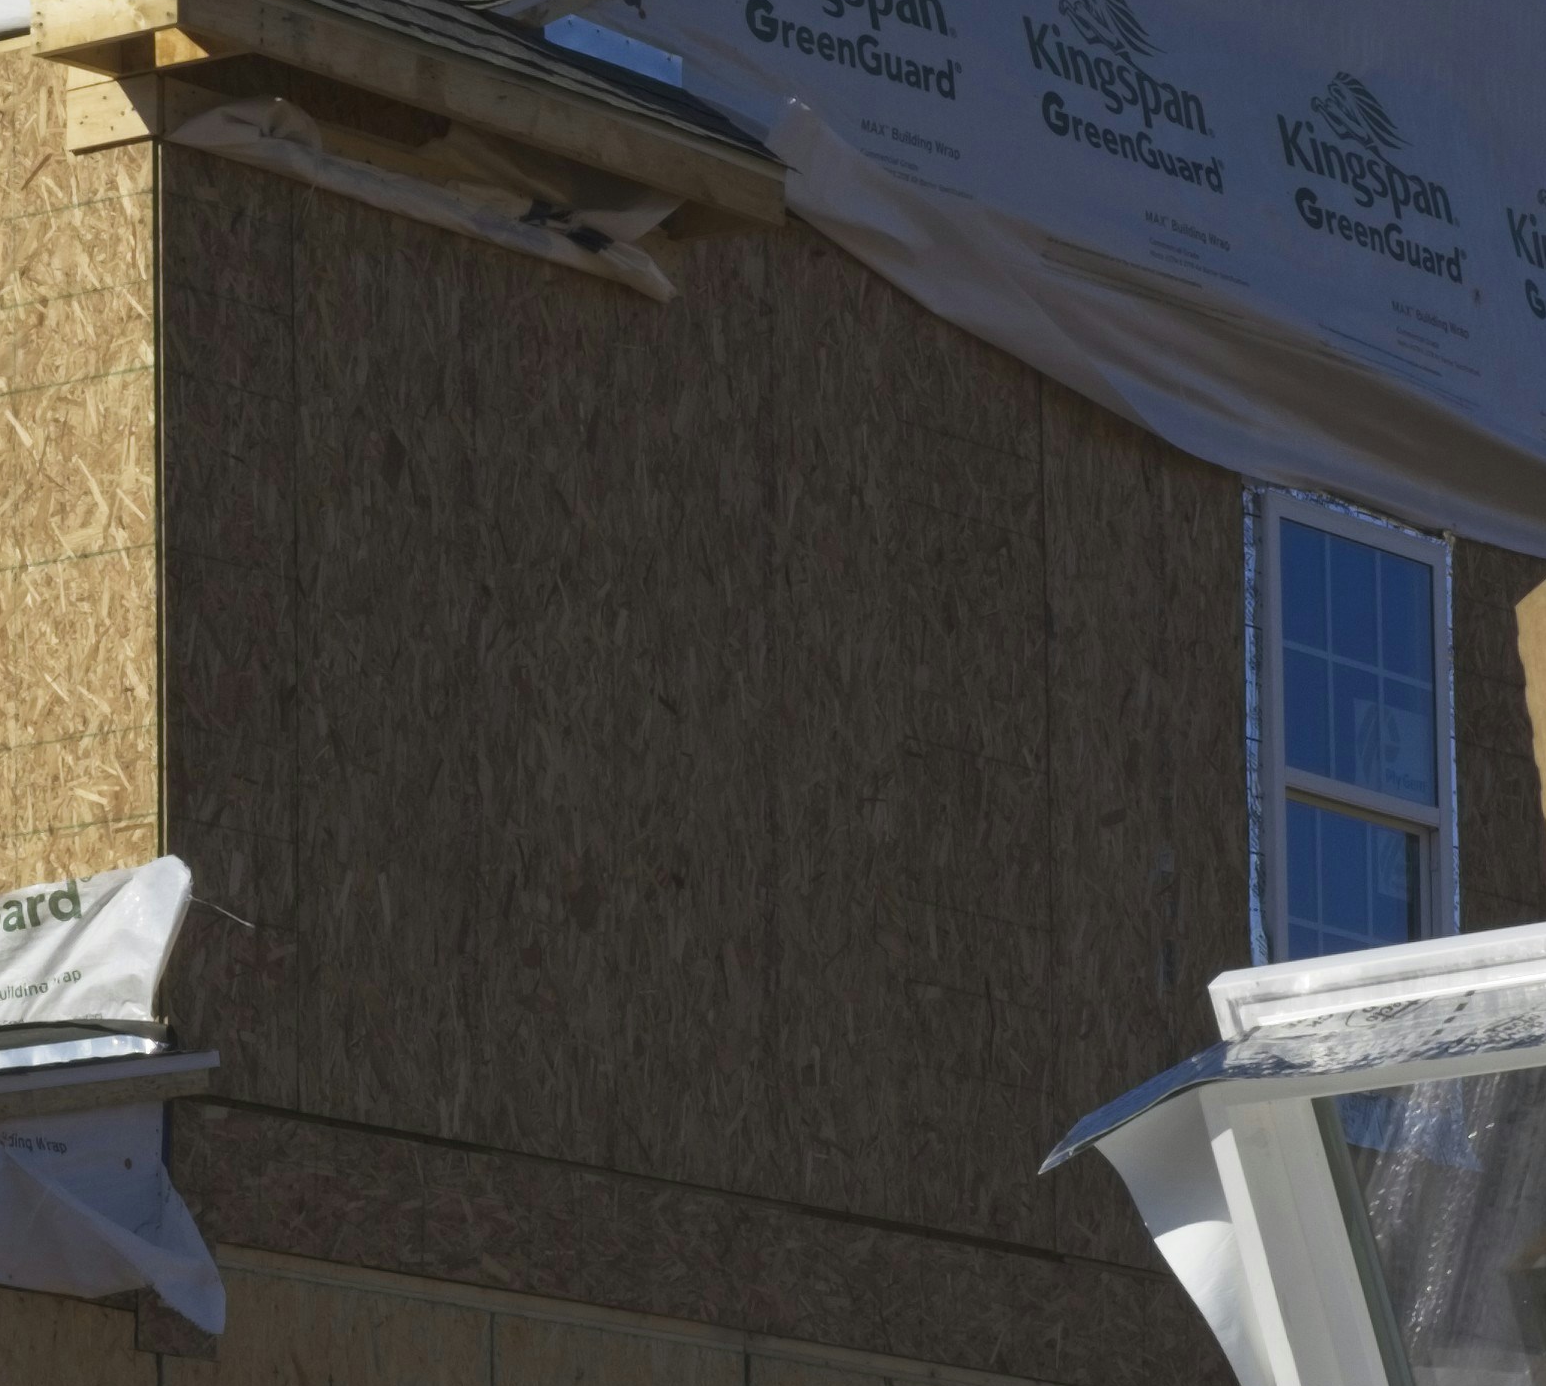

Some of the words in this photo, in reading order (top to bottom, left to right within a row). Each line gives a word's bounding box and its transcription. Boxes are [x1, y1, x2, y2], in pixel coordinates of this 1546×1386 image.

[1022, 13, 1209, 137] Kingspan
[892, 126, 932, 154] Building
[935, 140, 961, 161] Wrap
[1041, 91, 1225, 195] GreenGuard
[1277, 113, 1453, 227] Kingspan
[1171, 218, 1207, 246] Building
[1208, 232, 1231, 253] Wrap
[1294, 187, 1463, 285] GreenGuard
[36, 1132, 68, 1155] Wrap
